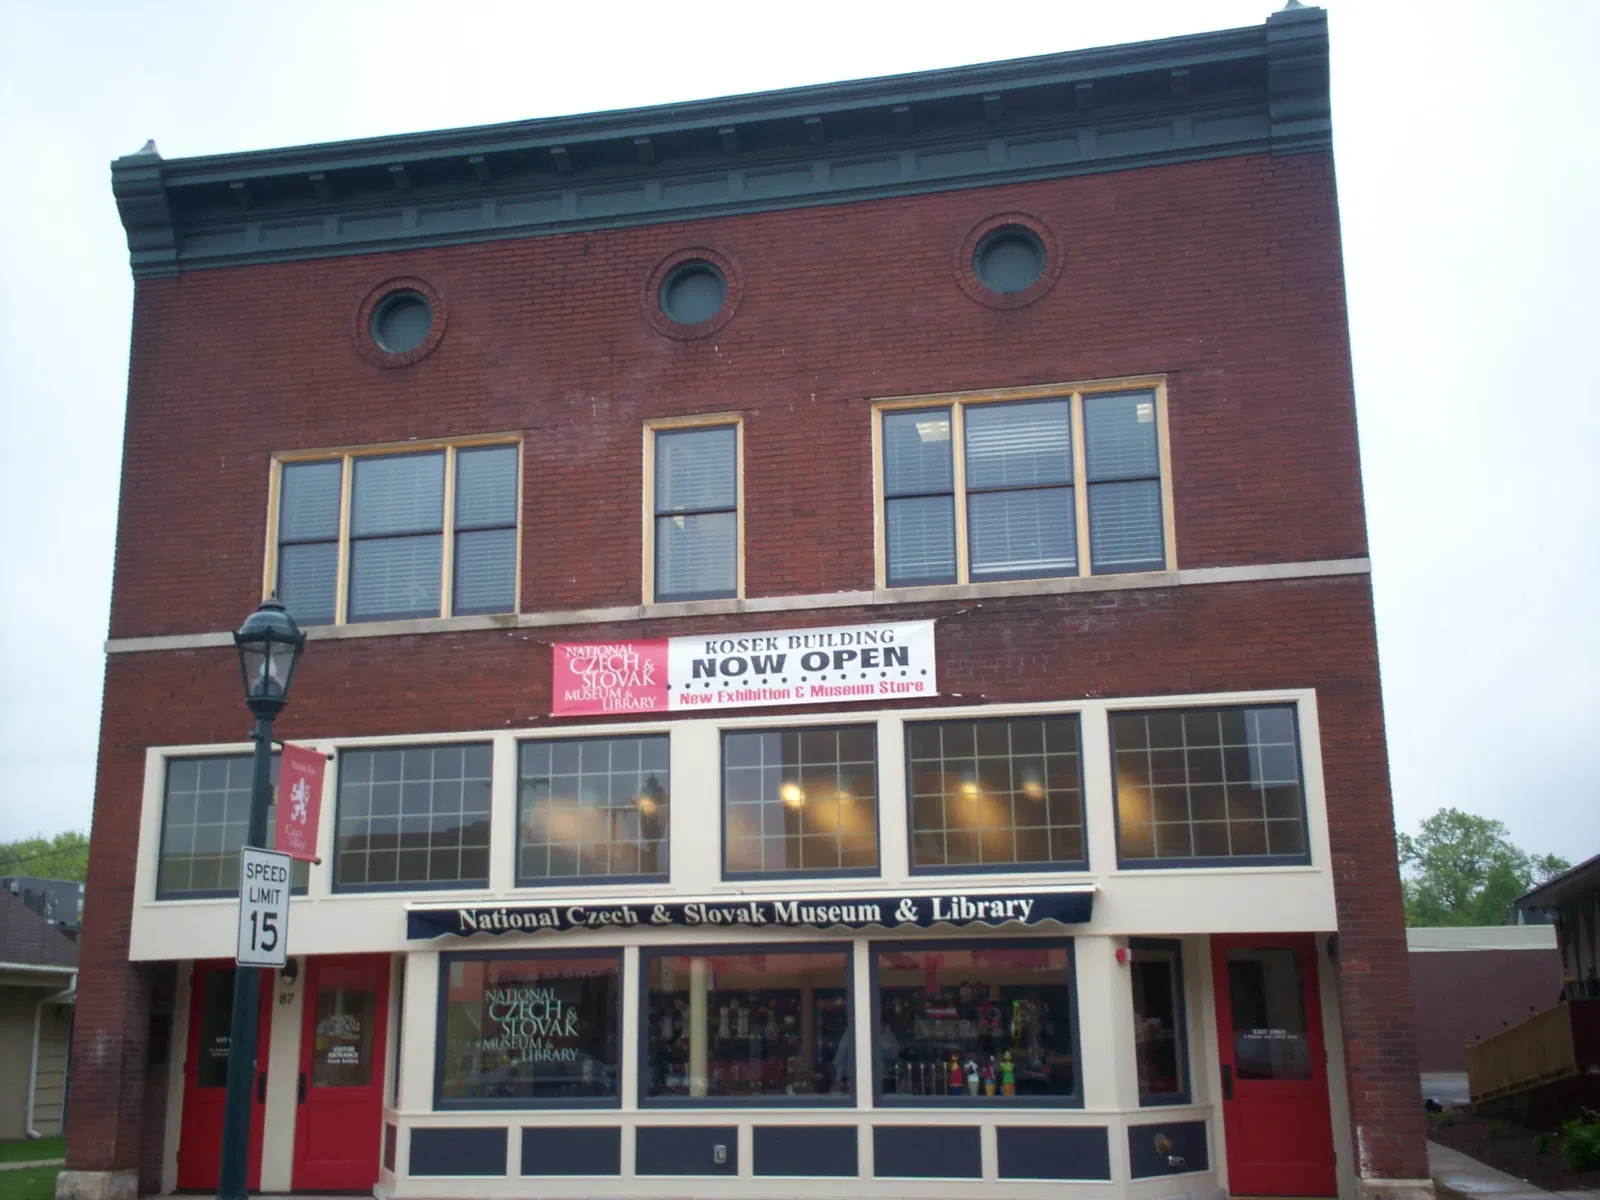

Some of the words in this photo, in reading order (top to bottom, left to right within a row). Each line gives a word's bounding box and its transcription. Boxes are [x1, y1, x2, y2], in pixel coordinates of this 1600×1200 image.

[788, 629, 895, 649] BUILDING
[566, 644, 636, 657] NATIONAL
[570, 653, 639, 675] CZECH
[692, 654, 787, 679] NOW
[800, 646, 909, 672] OPEN
[582, 669, 656, 689] SLOVAK
[564, 688, 621, 701] MUSEUM
[679, 692, 713, 705] New
[717, 687, 790, 703] Exhibition
[795, 686, 805, 698] &
[810, 684, 874, 698] Museum
[879, 681, 924, 694] Store
[602, 697, 656, 711] LIBRARY
[246, 862, 287, 883] SPEED
[249, 886, 281, 905] LIMIT
[458, 908, 560, 930] National
[565, 905, 639, 925] Czech
[650, 904, 672, 923] &
[683, 902, 771, 923] Slovak
[773, 901, 881, 923] Museum
[895, 898, 919, 921] &
[931, 896, 1034, 921] Library
[250, 910, 278, 952] 15
[485, 988, 557, 1002] NATIONAL
[489, 1000, 562, 1021] CZECH
[502, 1017, 578, 1037] SLOVAK
[482, 1035, 542, 1050] MUSEUM
[522, 1049, 579, 1061] LIBRARY
